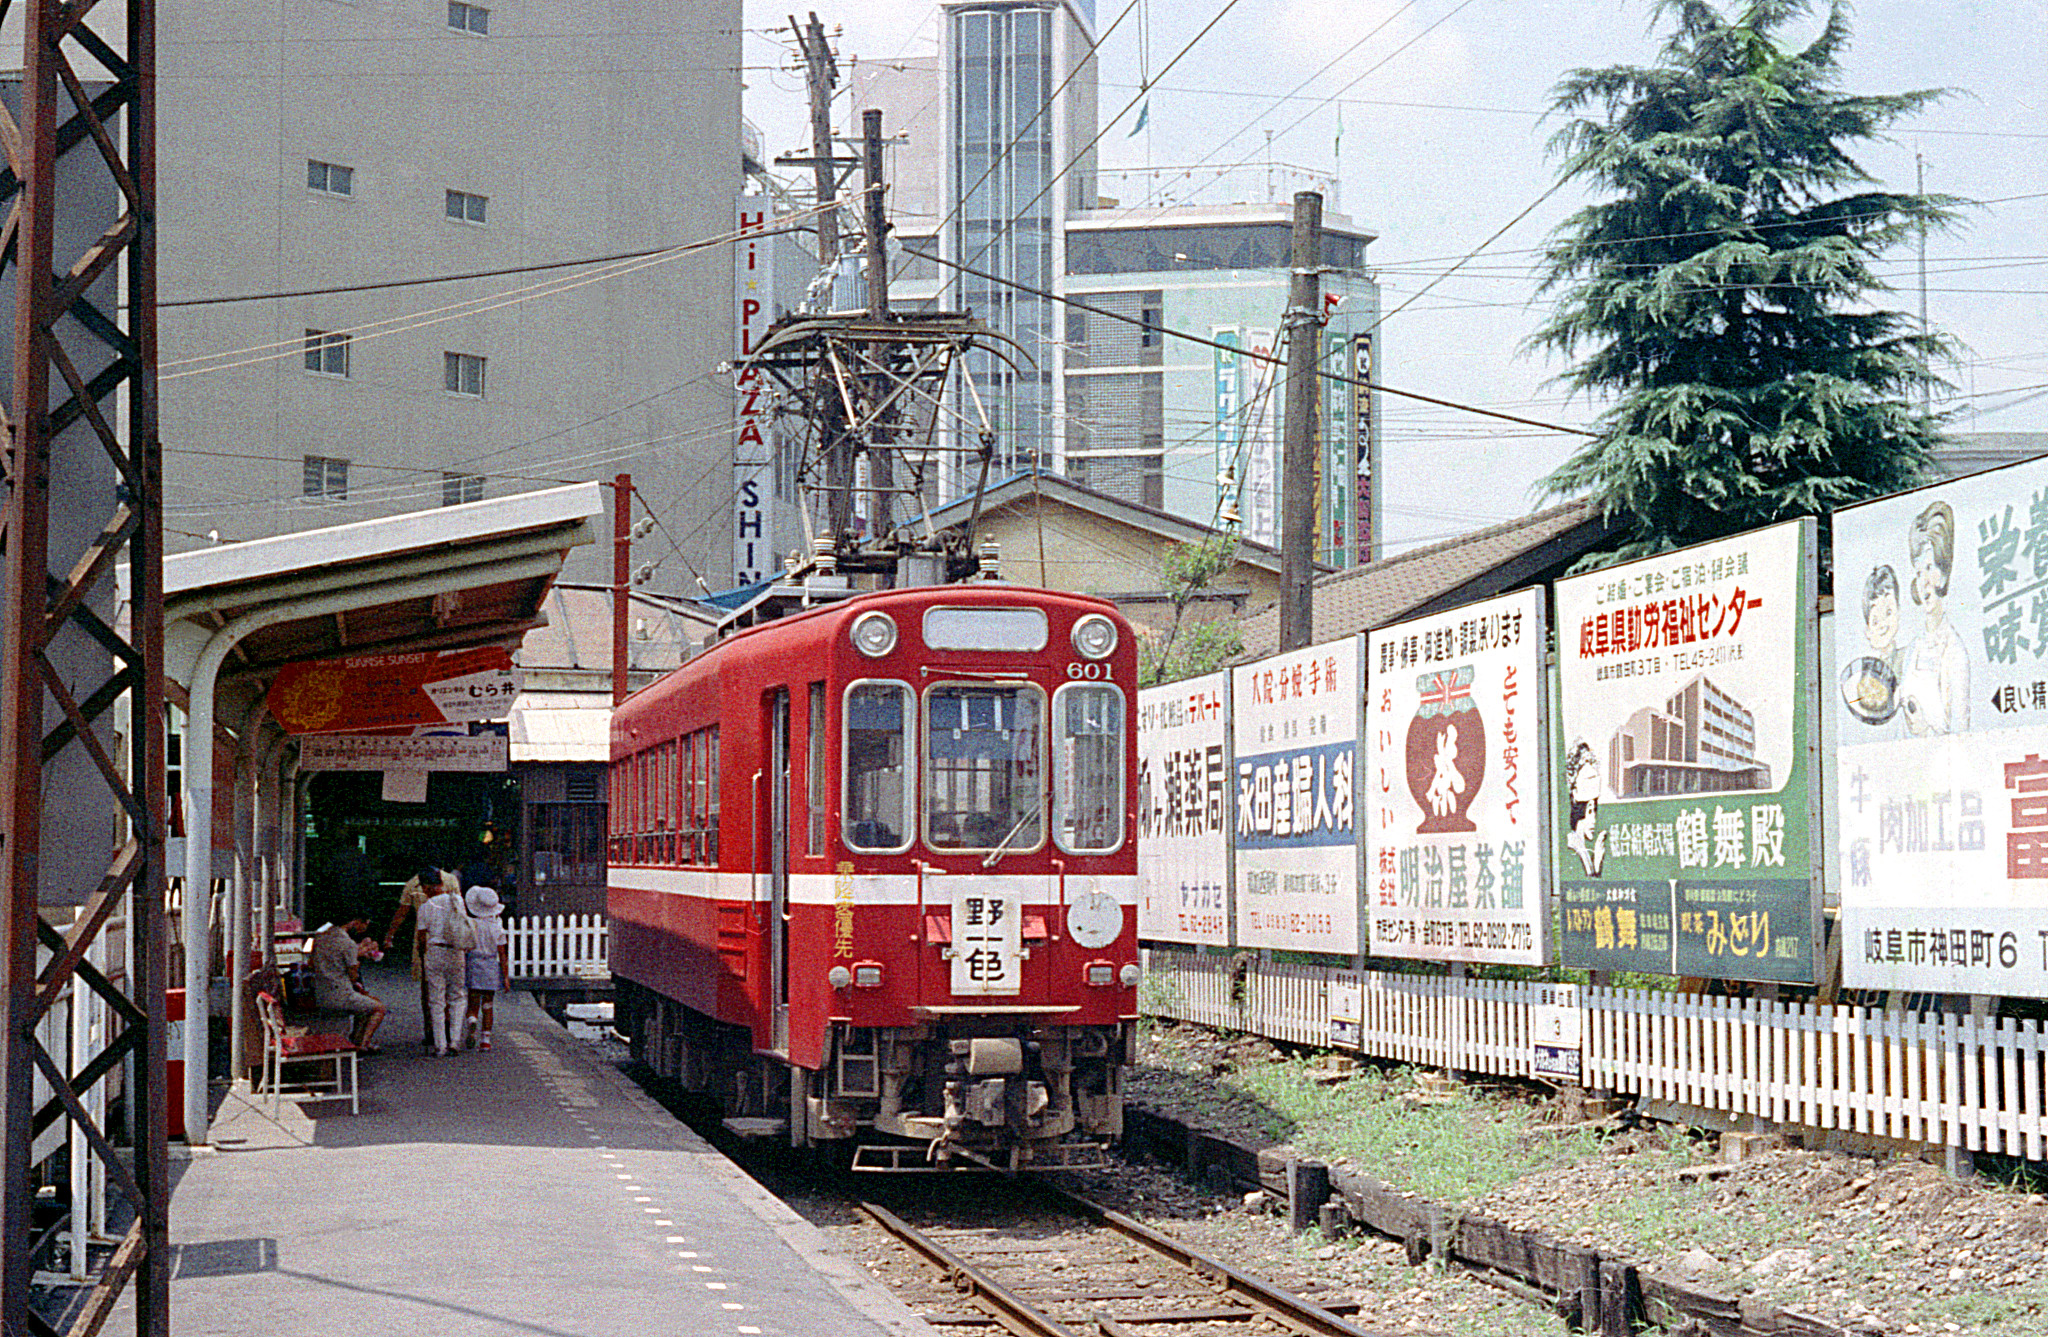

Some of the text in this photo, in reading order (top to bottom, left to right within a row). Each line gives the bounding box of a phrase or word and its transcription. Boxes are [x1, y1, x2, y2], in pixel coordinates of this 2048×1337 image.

[740, 211, 764, 270] Hi
[1579, 586, 1763, 659] 岐阜県勤労福祉センター
[387, 652, 426, 667] SUNSET
[1066, 662, 1115, 681] 601
[468, 681, 516, 698] むら井
[2003, 681, 2047, 714] 良い精
[1379, 688, 1394, 830] おいしい
[1502, 665, 1520, 825] とても安くて
[1237, 749, 1354, 837] 永田産婦人科
[1879, 789, 1986, 855] 肉加工品
[1675, 803, 1786, 870] 鶴舞殿
[1400, 840, 1525, 910] 明治屋茶舗
[965, 898, 1006, 982] 野一色
[1594, 904, 1637, 951] 鶴舞
[1706, 909, 1770, 959] みどり
[1863, 928, 2018, 969] 岐阜市神田町6
[1553, 1017, 1562, 1040] 3
